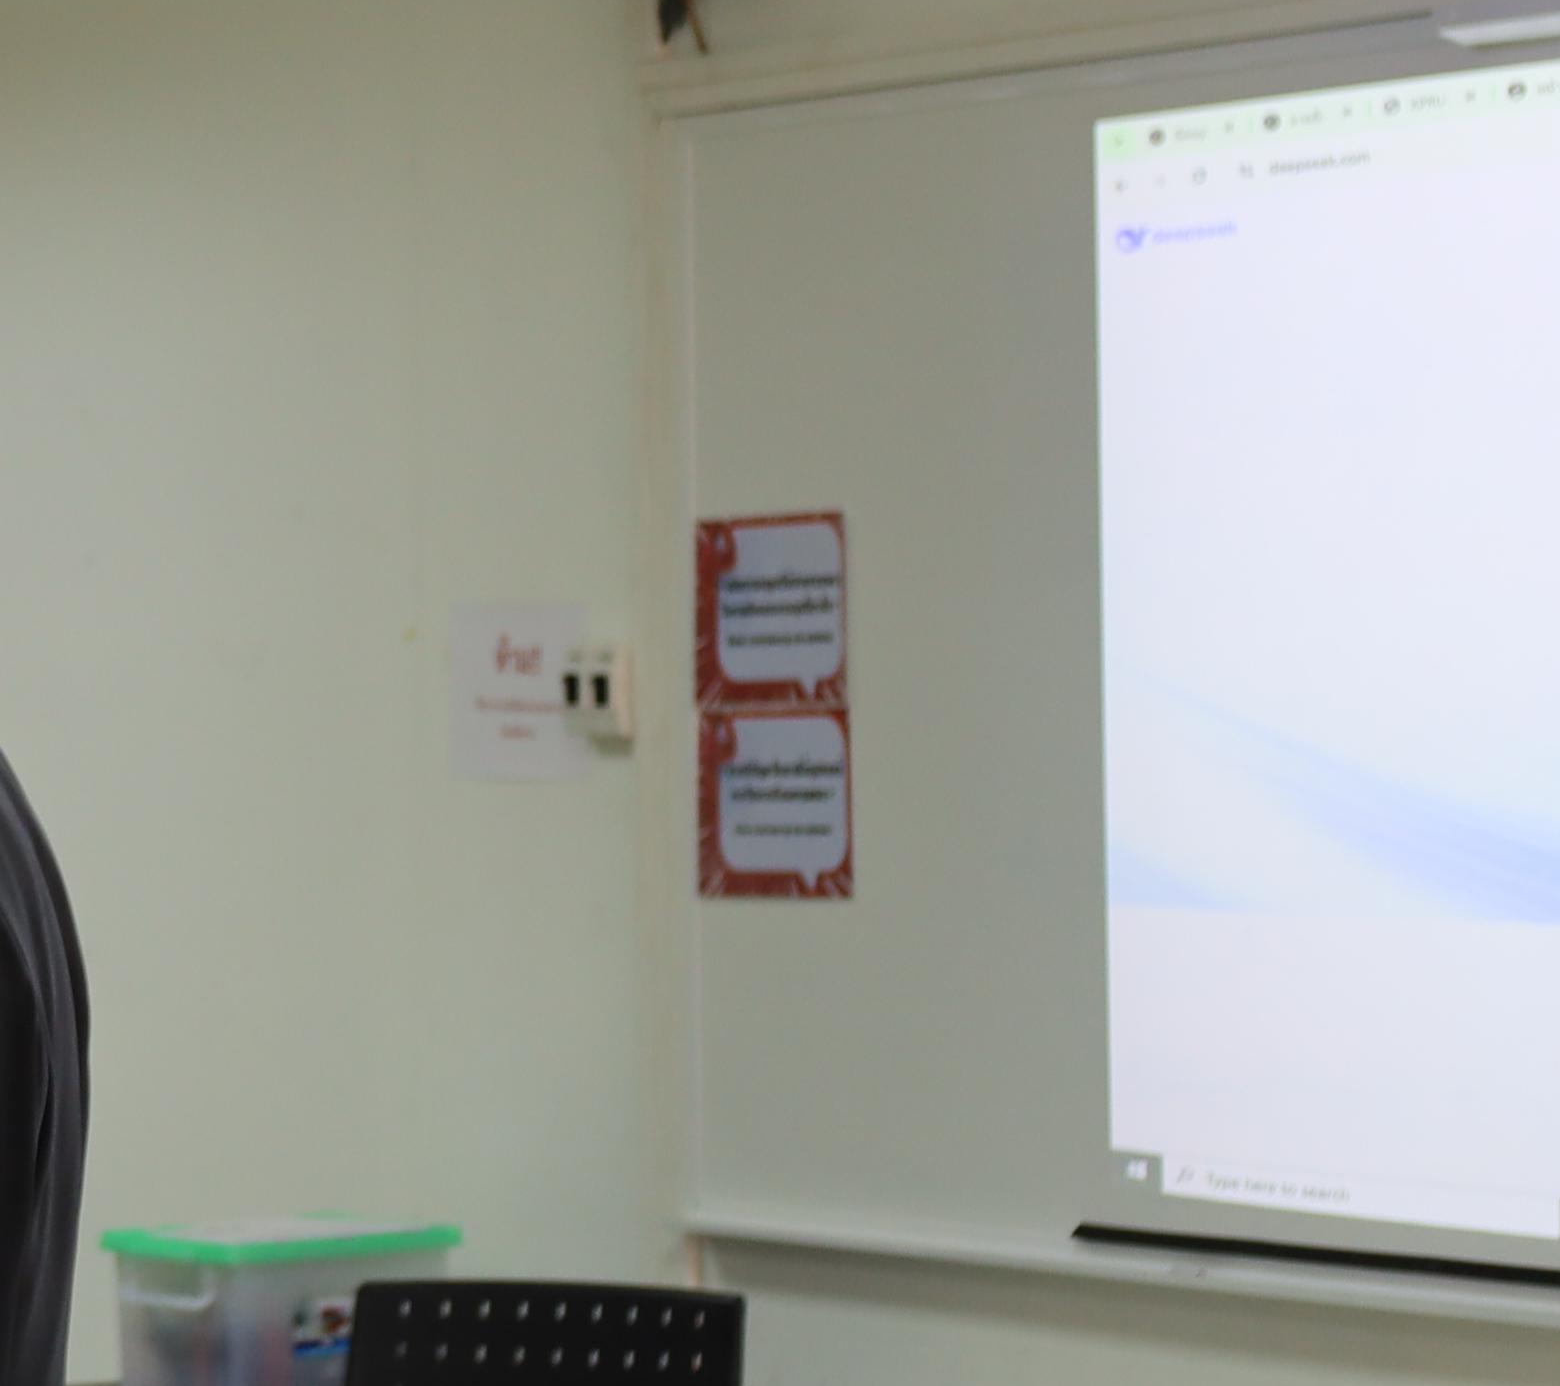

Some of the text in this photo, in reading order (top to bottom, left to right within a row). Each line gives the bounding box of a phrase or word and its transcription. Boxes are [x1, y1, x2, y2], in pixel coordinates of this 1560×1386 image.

[1266, 150, 1372, 176] deepseek.com
[1205, 1171, 1238, 1195] Type
[1244, 1175, 1276, 1195] here
[1301, 1181, 1350, 1204] search
